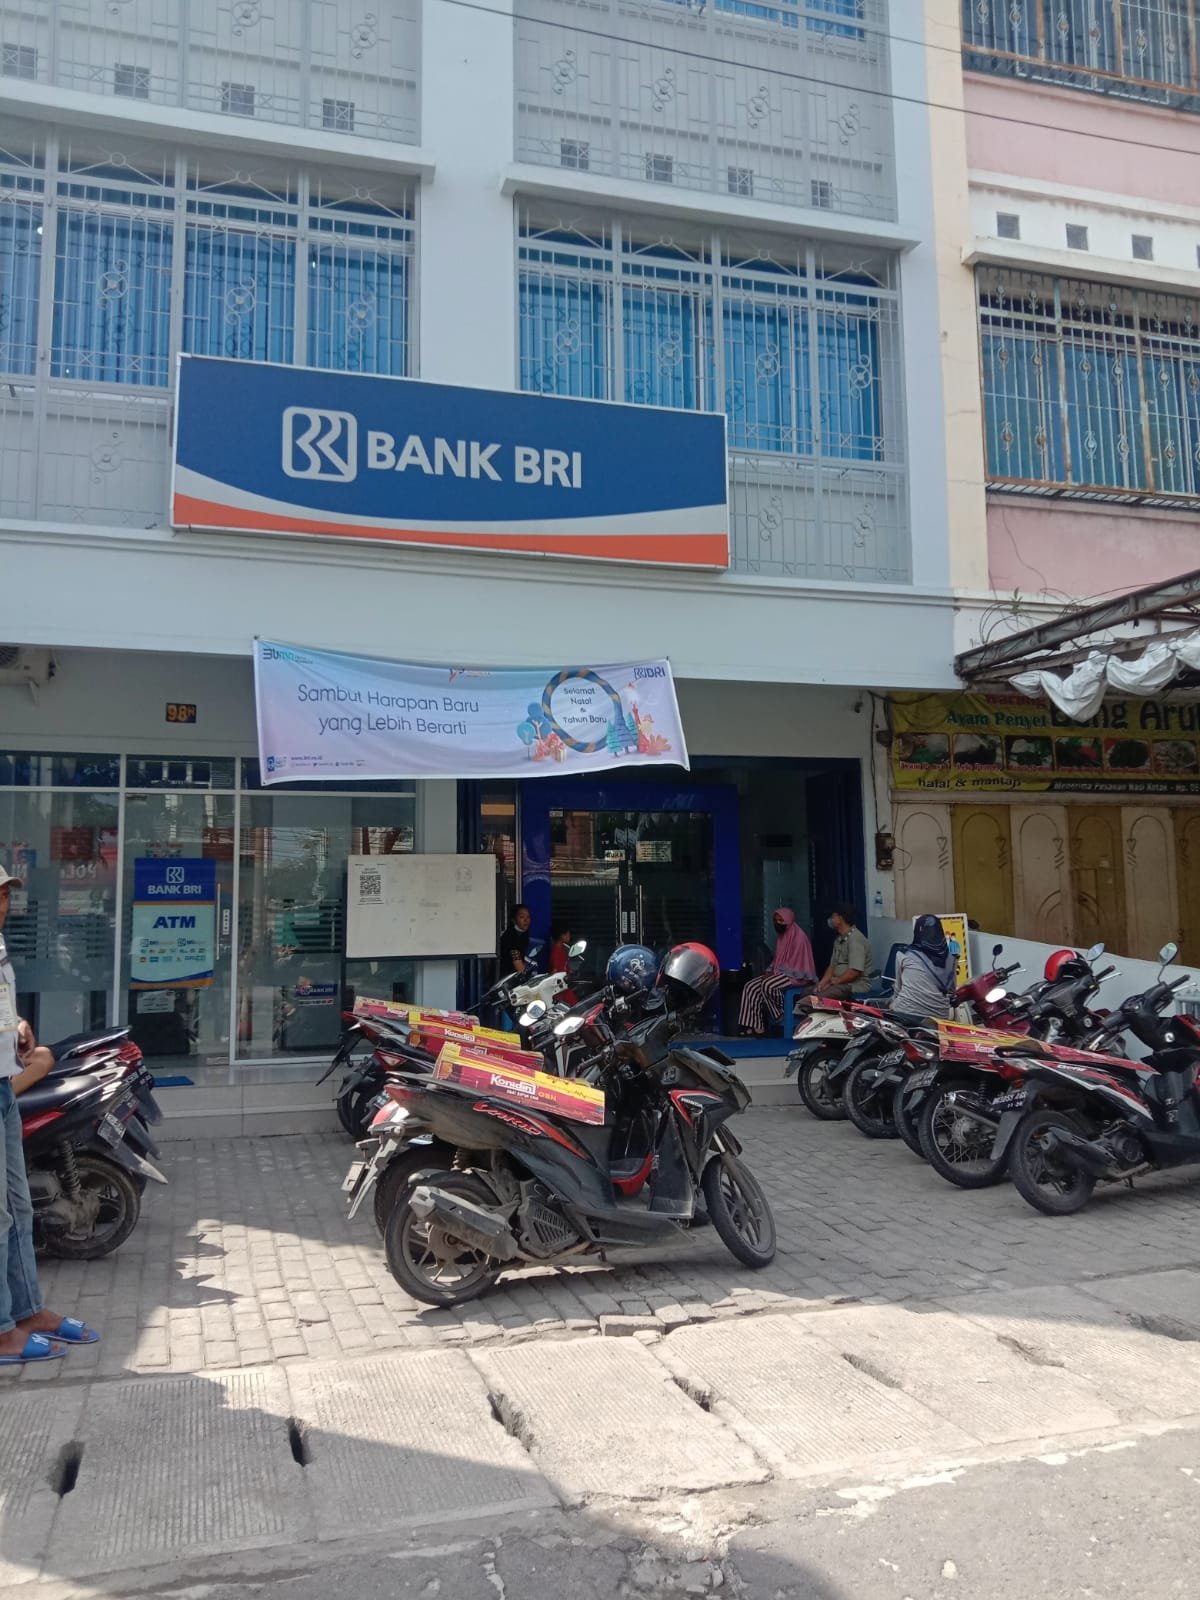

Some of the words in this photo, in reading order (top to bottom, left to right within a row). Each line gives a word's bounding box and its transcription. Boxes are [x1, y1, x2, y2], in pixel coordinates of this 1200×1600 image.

[367, 431, 502, 482] BANK
[514, 447, 583, 490] BRI
[563, 687, 595, 696] Selamat
[298, 684, 363, 704] Sambut
[367, 691, 439, 713] Harapan
[443, 696, 479, 713] Baru
[570, 697, 592, 705] Natal
[318, 716, 362, 735] yang
[367, 713, 412, 731] Lebih
[417, 718, 467, 736] Berarti
[563, 715, 588, 724] Tahun
[589, 715, 607, 724] Baru
[947, 710, 989, 727] Ayam
[995, 711, 1046, 729] Penyet
[918, 778, 950, 789] halal
[955, 778, 968, 787] &
[971, 777, 1021, 789] mantap
[147, 884, 181, 895] BANK
[183, 885, 202, 895] BRI
[153, 916, 196, 929] ATM
[490, 1073, 537, 1095] Konidin
